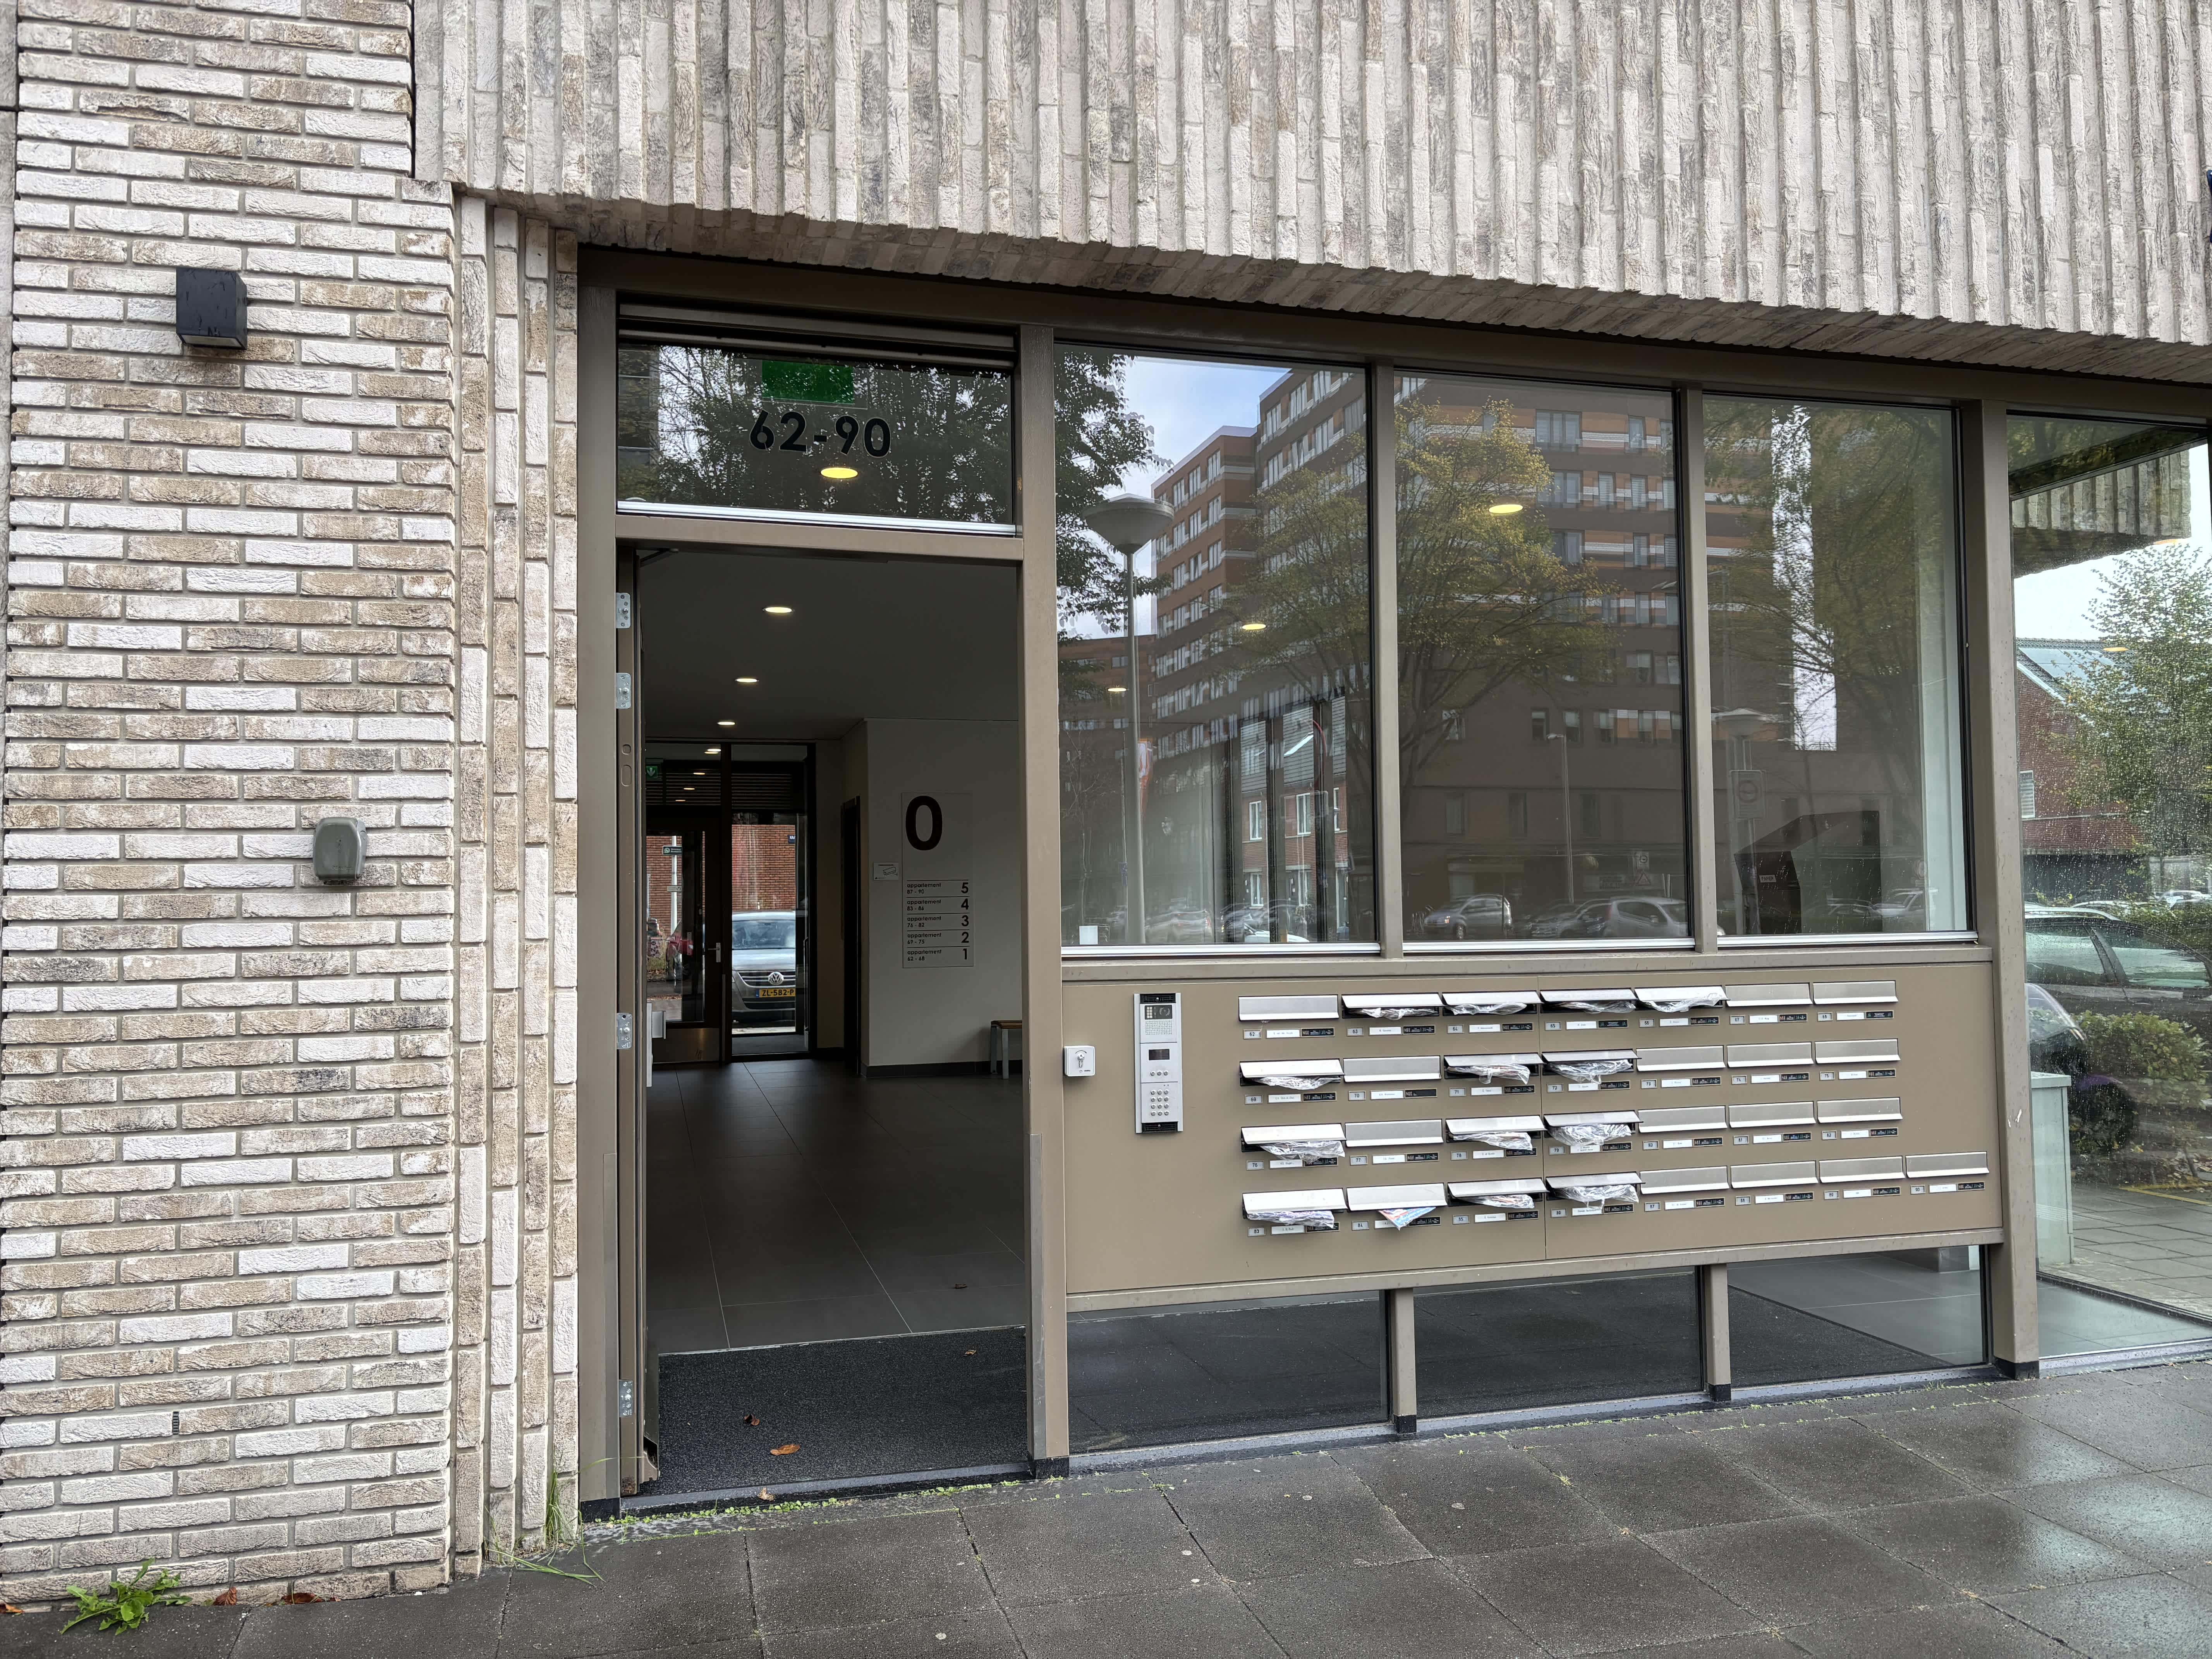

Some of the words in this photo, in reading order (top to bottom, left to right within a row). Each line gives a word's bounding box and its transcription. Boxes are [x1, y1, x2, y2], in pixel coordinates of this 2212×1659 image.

[750, 409, 891, 458] 62-90
[905, 795, 943, 850] 0
[961, 883, 969, 893] 5
[961, 898, 969, 910] 4
[961, 915, 969, 926] 3
[961, 932, 969, 943] 2
[963, 948, 967, 960] 1
